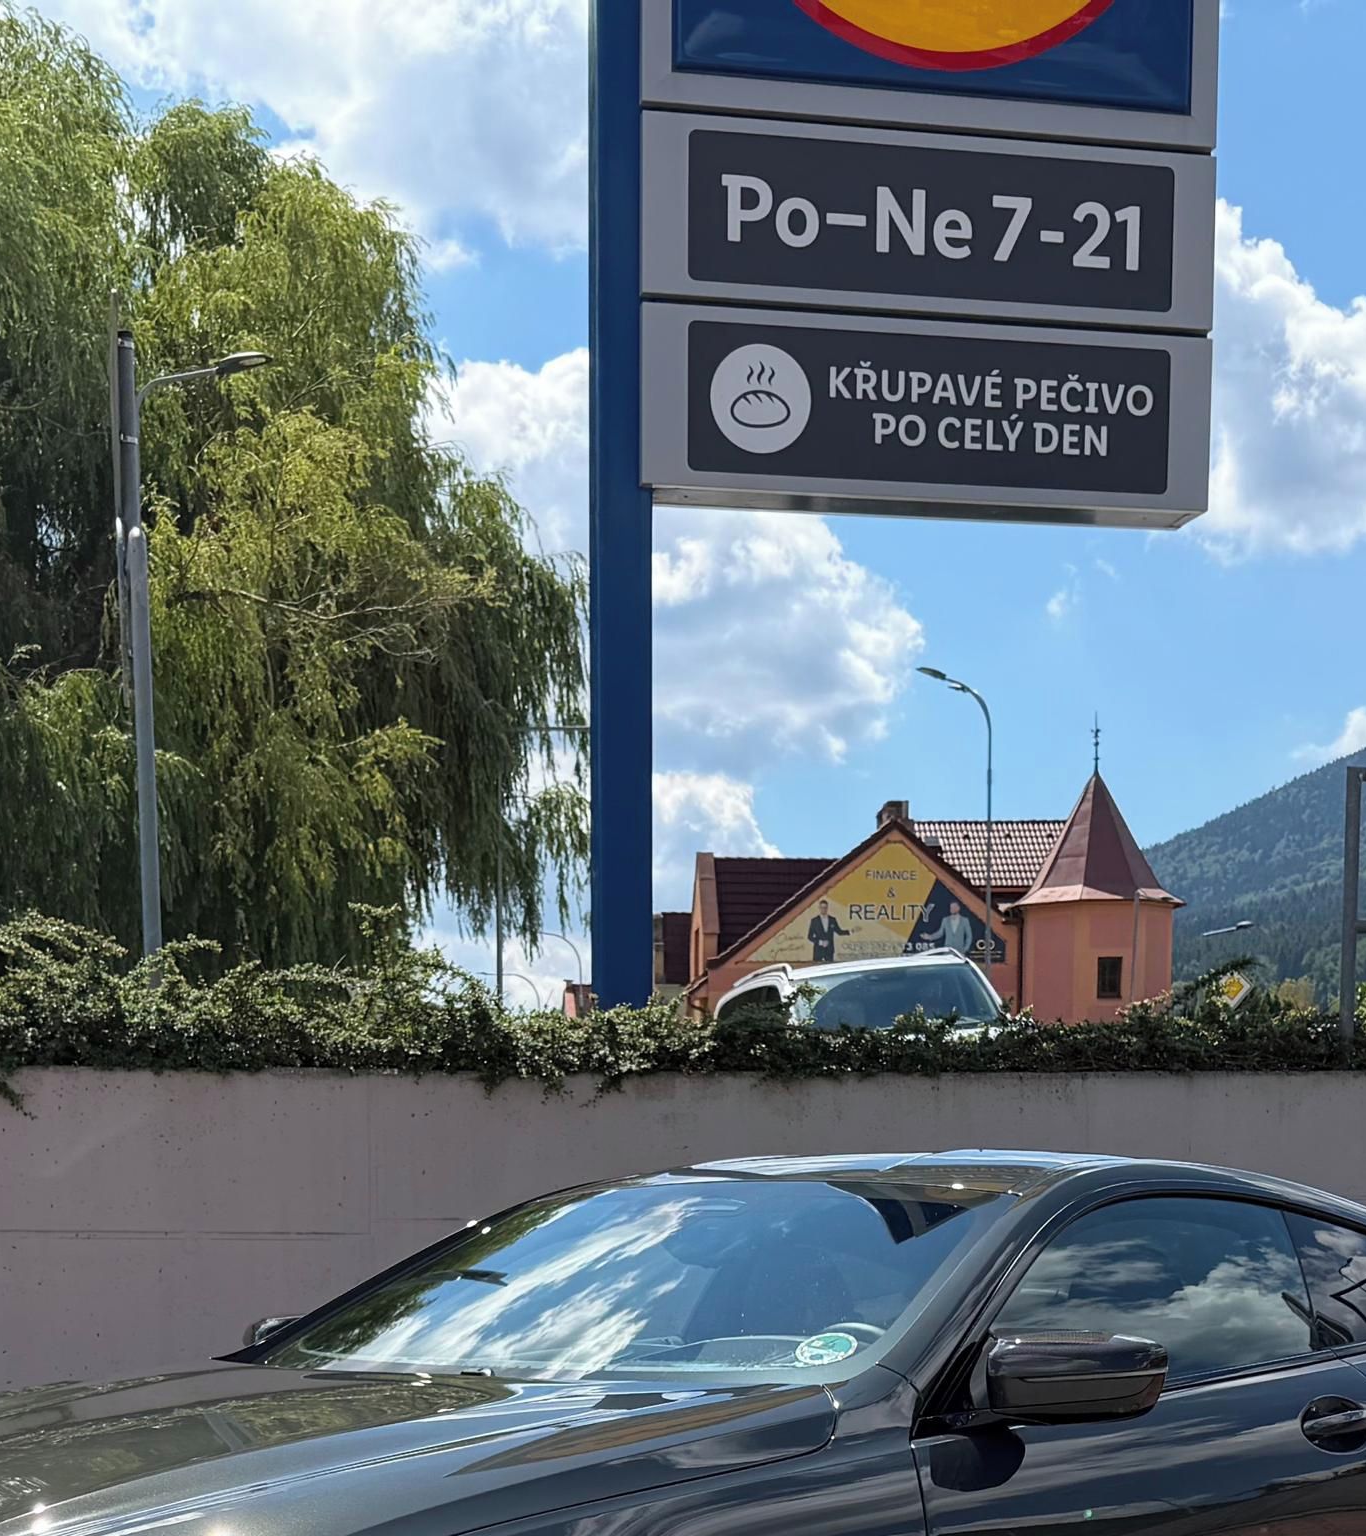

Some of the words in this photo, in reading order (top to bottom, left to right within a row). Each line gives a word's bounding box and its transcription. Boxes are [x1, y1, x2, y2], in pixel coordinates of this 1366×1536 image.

[992, 195, 1141, 271] 7-21
[829, 361, 1003, 408] KŘUPAVÉ
[1013, 374, 1154, 417] PEČIVO
[872, 412, 927, 446] PO
[937, 413, 1024, 452] CELÝ
[1034, 421, 1109, 456] DEN
[865, 870, 918, 881] FINANCE
[849, 904, 935, 923] REALITY
